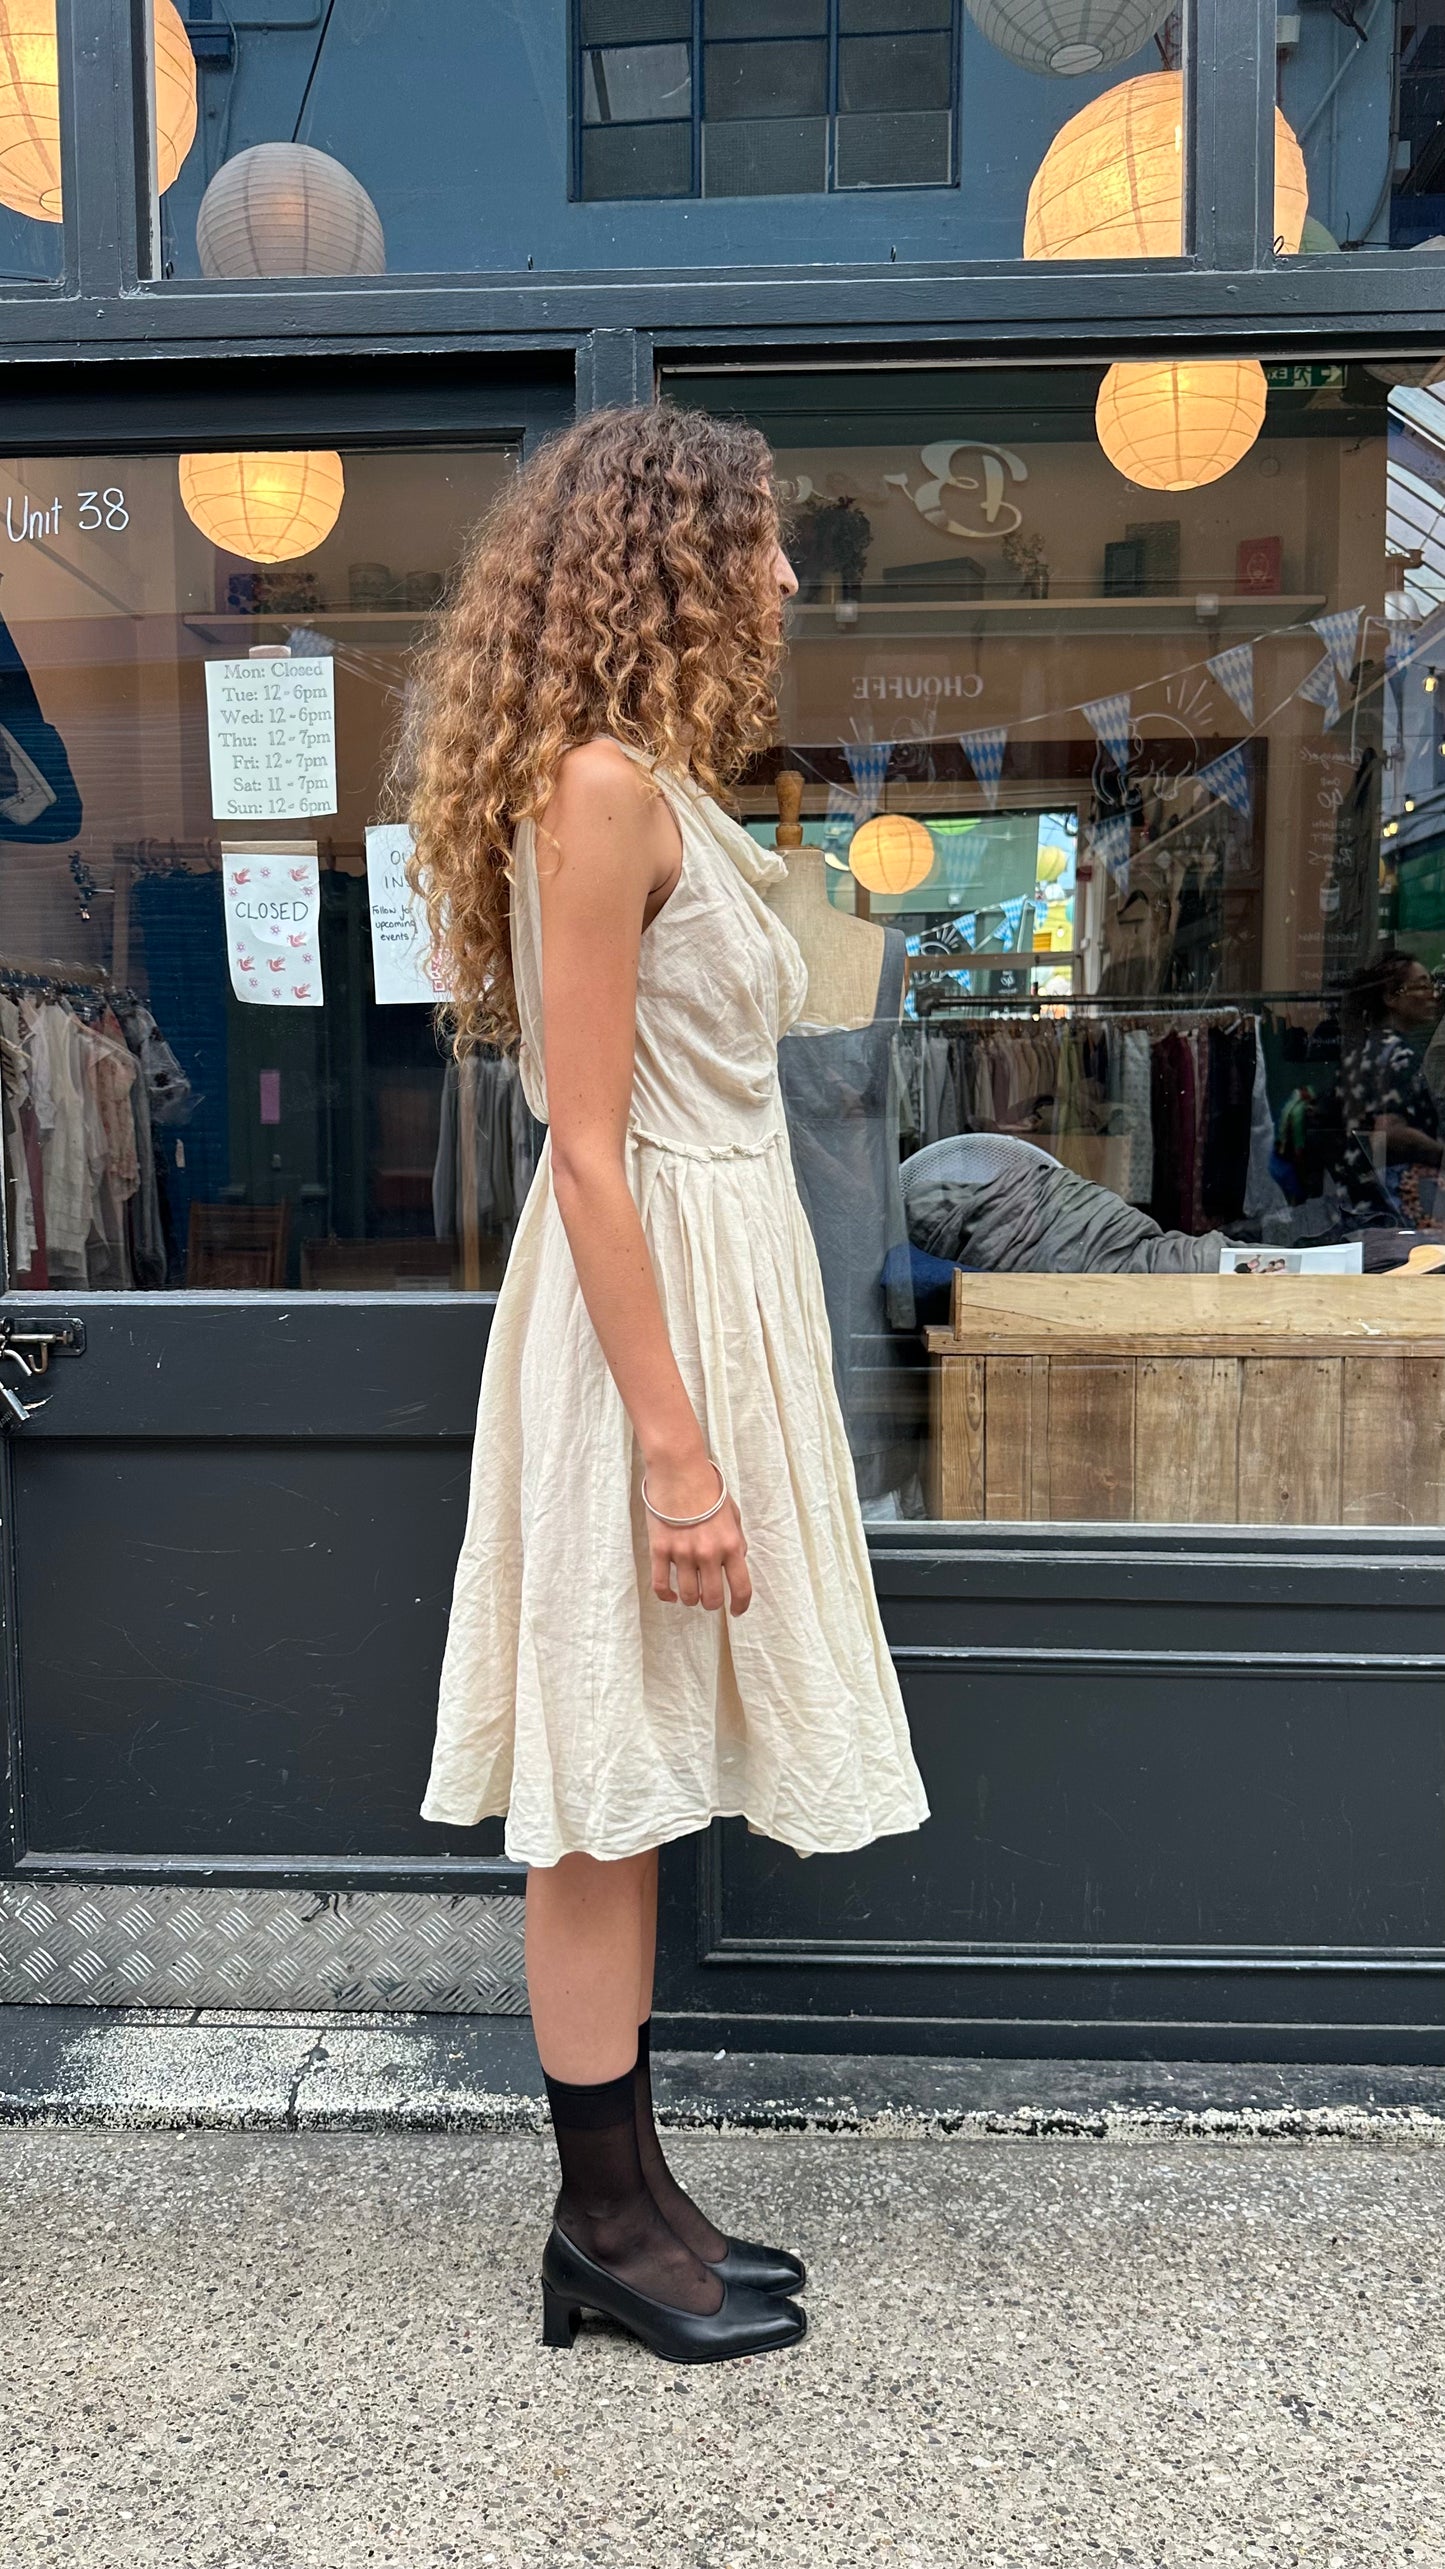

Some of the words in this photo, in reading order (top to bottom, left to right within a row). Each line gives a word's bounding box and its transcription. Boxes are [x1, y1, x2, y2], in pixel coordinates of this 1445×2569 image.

[6, 495, 63, 542] Unit
[77, 487, 130, 531] 38
[224, 664, 266, 680] Mon:
[270, 661, 324, 677] Closed
[222, 687, 258, 702] Tue:
[263, 684, 282, 701] 12
[293, 684, 328, 703] 6pm
[220, 708, 264, 725] Wed:
[268, 707, 287, 723] 12
[298, 707, 332, 726] 6pm
[217, 732, 257, 747] Thu:
[268, 729, 286, 746] 12
[299, 729, 331, 748] 7pm
[232, 754, 260, 769] Fri:
[265, 752, 283, 769] 12
[296, 753, 328, 772] 7pm
[233, 777, 262, 792] Sat:
[267, 776, 282, 791] 11
[297, 775, 329, 794] 7pm
[227, 799, 263, 814] Sun:
[269, 797, 287, 814] 12
[300, 797, 332, 816] 6pm
[235, 901, 309, 921] CLOSED
[372, 904, 397, 915] Follow
[375, 920, 418, 934] upcoming
